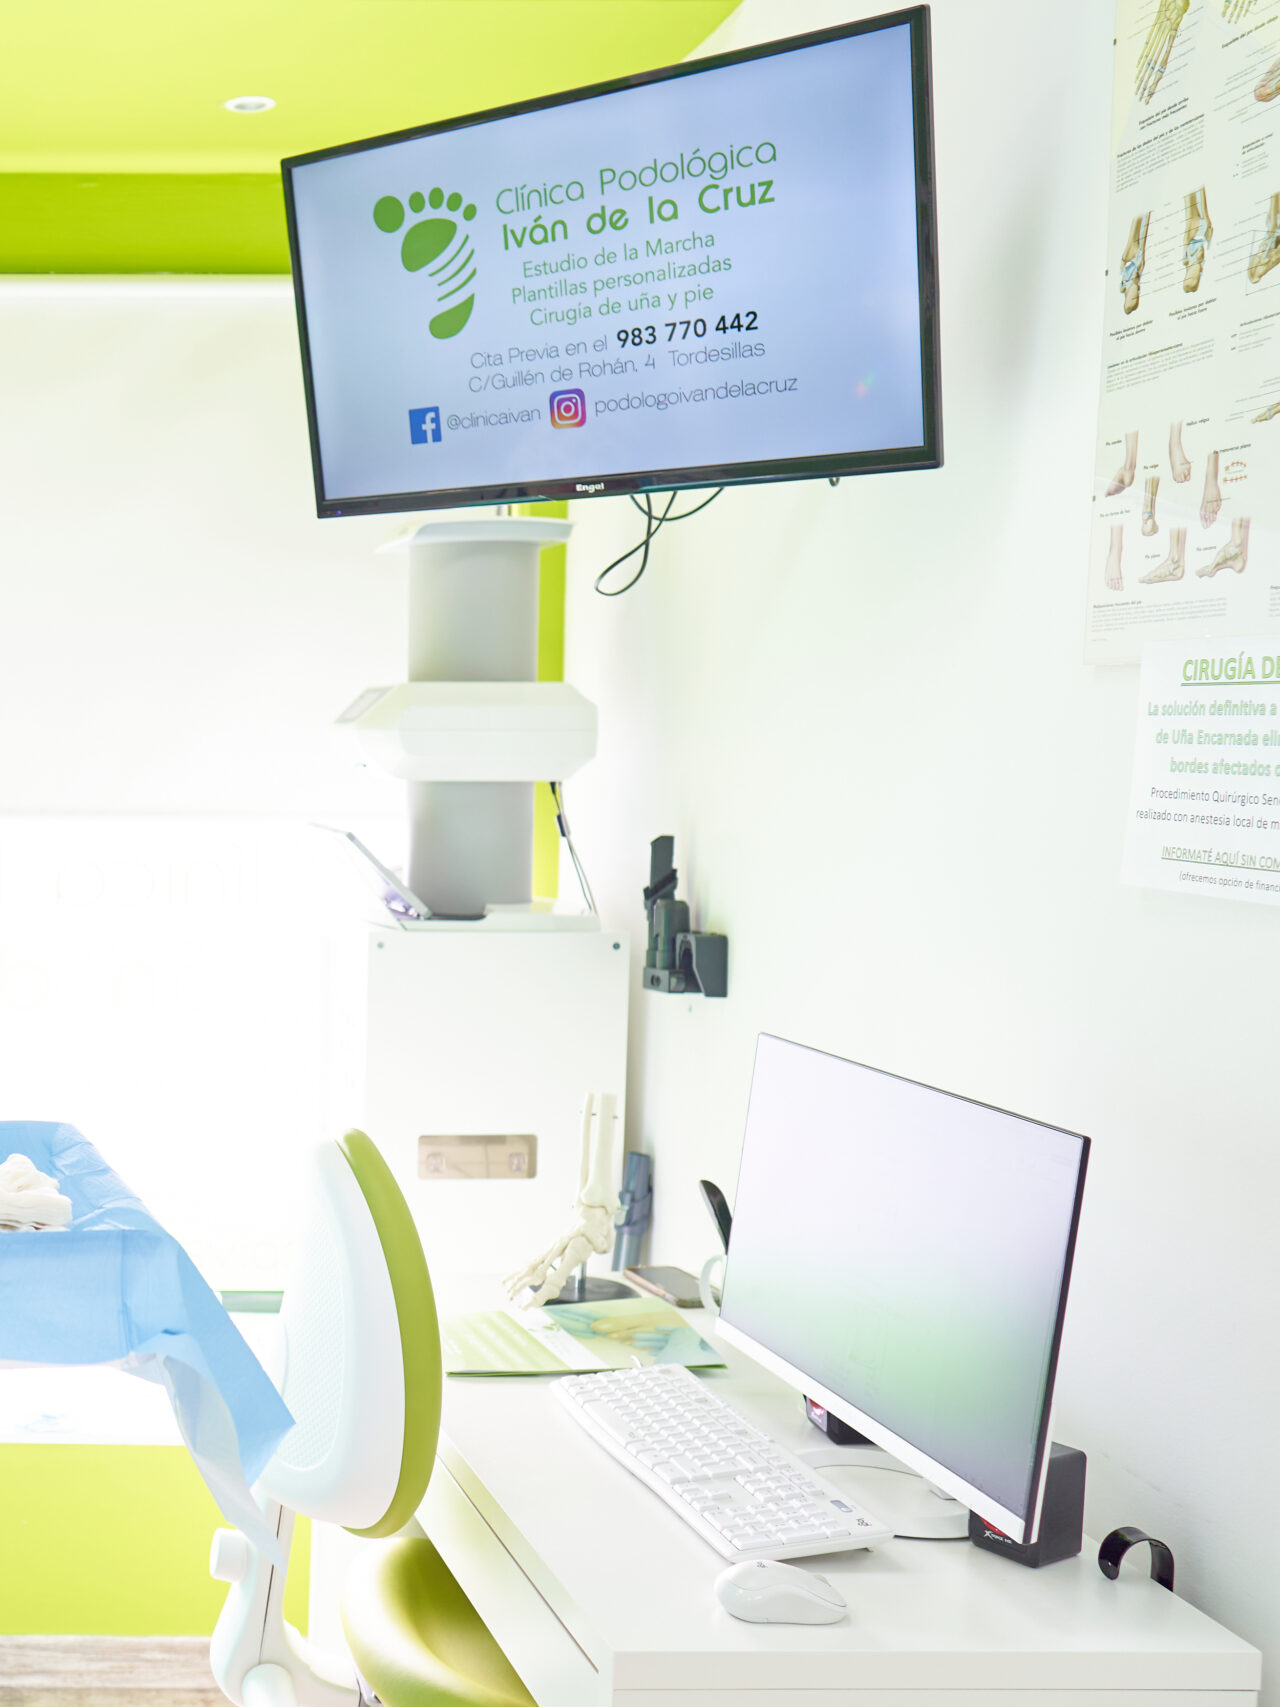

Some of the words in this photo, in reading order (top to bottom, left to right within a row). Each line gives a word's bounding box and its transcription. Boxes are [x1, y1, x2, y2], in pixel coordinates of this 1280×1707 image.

[496, 181, 585, 214] Clínica
[600, 141, 777, 196] Podológica
[502, 214, 568, 250] Iván
[586, 205, 629, 235] de
[648, 195, 679, 224] la
[698, 179, 776, 214] Cruz
[522, 253, 588, 278] Estudio
[594, 247, 617, 267] de
[624, 243, 639, 261] la
[646, 231, 715, 258] Marcha
[511, 279, 588, 304] Plantillas
[593, 255, 733, 297] personalizadas
[529, 302, 592, 326] Cirugía
[598, 297, 622, 316] de
[628, 292, 661, 312] uña
[668, 292, 678, 311] y
[684, 284, 715, 309] pie
[470, 351, 503, 370] Cita
[508, 342, 560, 364] Previa
[565, 341, 587, 356] en
[593, 335, 607, 353] el
[616, 325, 658, 349] 983
[664, 318, 707, 342] 770
[715, 310, 759, 334] 442
[468, 367, 545, 393] C/Guillén
[550, 364, 573, 384] de
[644, 353, 656, 371] 4
[668, 341, 766, 367] Tordesillas
[594, 375, 799, 417] podologoivandelacruz
[446, 405, 541, 431] @clinicaivan
[575, 482, 605, 494] Engel
[1182, 651, 1256, 681] CIRUGÍA
[1147, 701, 1160, 716] La
[1161, 699, 1206, 716] solución
[1209, 699, 1266, 716] definitiva
[1269, 702, 1277, 716] a
[1155, 728, 1169, 744] de
[1172, 728, 1194, 745] Uña
[1197, 729, 1259, 746] Encarnada
[1169, 756, 1209, 774] bordes
[1211, 758, 1271, 776] afectados
[1151, 786, 1210, 802] Procedimiento
[1212, 790, 1260, 807] Quirúrgico
[1262, 793, 1280, 806] Sen
[1136, 808, 1171, 821] realizado
[1173, 812, 1188, 823] con
[1190, 814, 1231, 826] anestesia
[1233, 815, 1254, 828] local
[1256, 816, 1268, 830] de
[1162, 845, 1213, 863] INFORMATÉ
[1215, 849, 1240, 866] AQUÍ
[1241, 853, 1257, 868] SIN
[1219, 876, 1242, 888] opción
[1244, 880, 1254, 890] de
